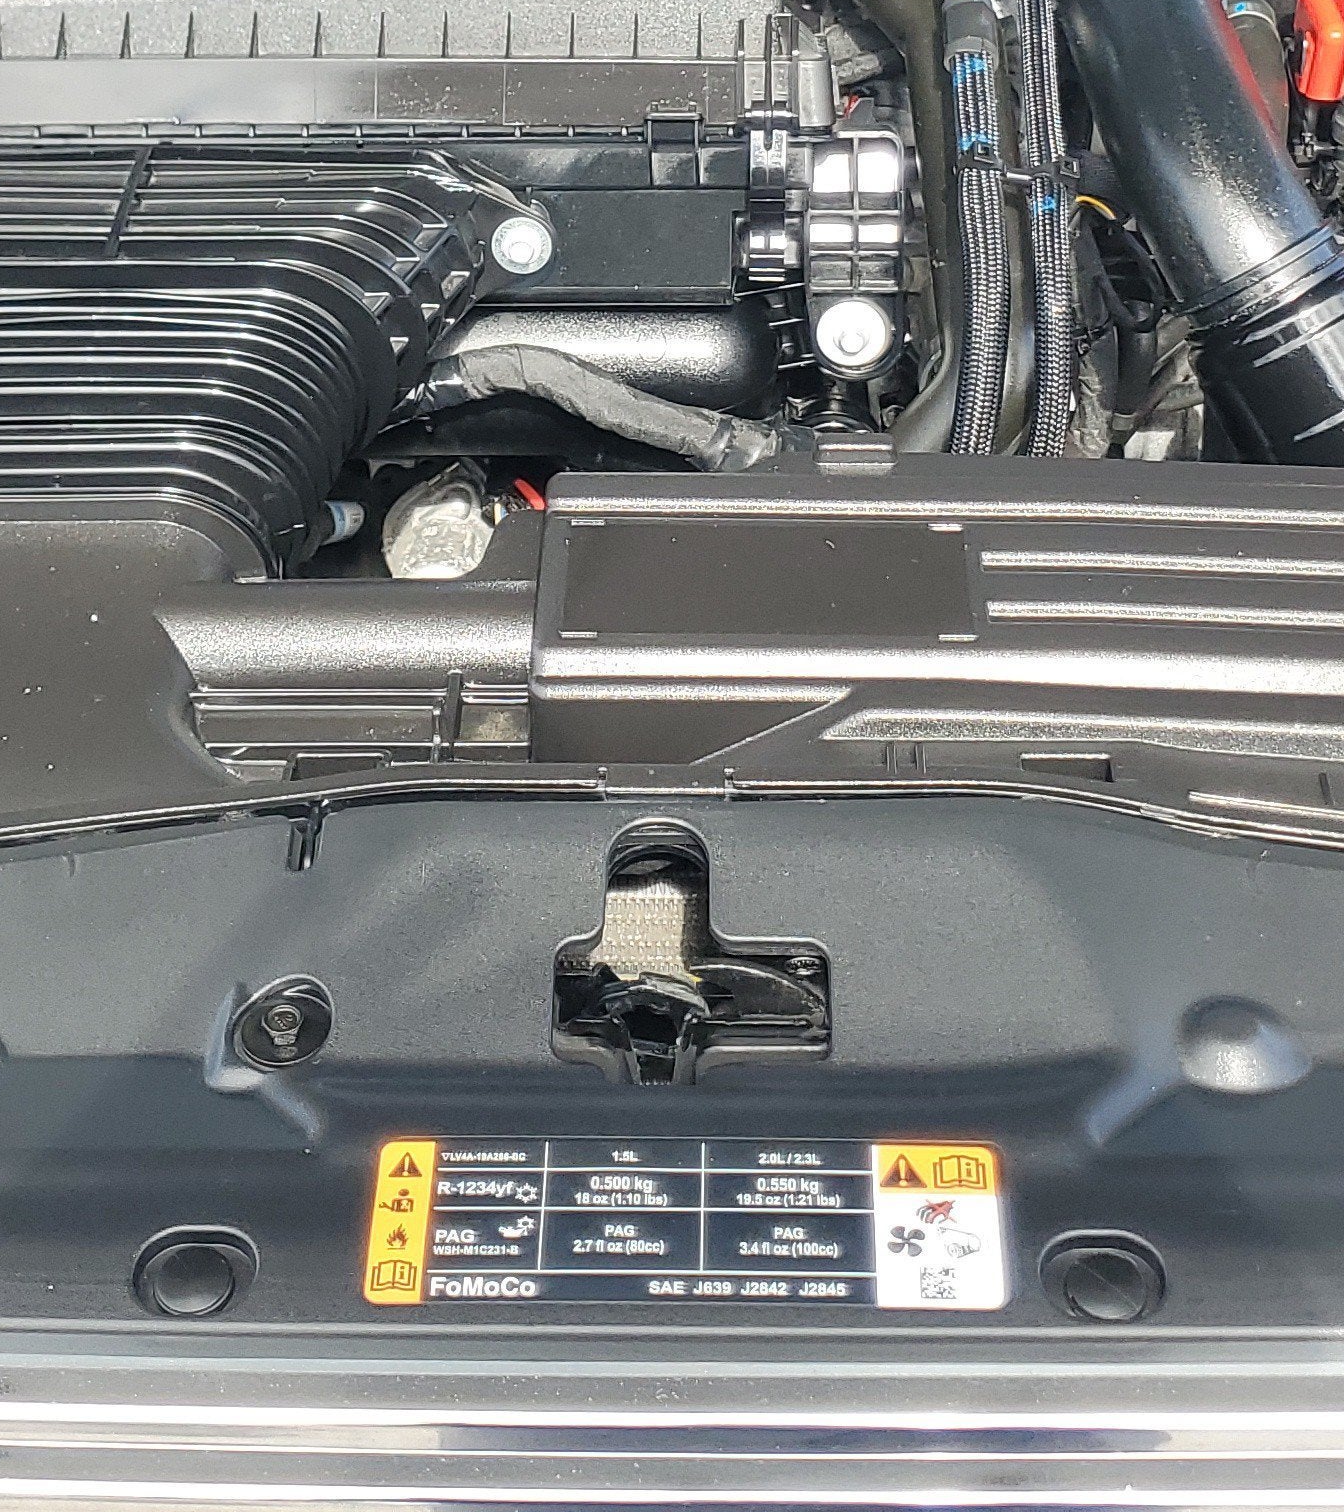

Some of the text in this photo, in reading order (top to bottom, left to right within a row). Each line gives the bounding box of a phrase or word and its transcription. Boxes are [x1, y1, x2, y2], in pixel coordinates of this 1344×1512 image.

[437, 1181, 514, 1197] R-1234yf
[590, 1176, 653, 1193] 0.500 kg
[757, 1178, 819, 1194] 0.550 kg
[575, 1192, 667, 1206] 18 oz (1.10 lbs)
[765, 1196, 781, 1205] oz
[783, 1194, 813, 1207] (1.21
[816, 1194, 840, 1207] lbs)
[434, 1229, 475, 1243] PAG
[605, 1225, 635, 1237] PAG
[774, 1227, 804, 1239] PAG
[573, 1240, 664, 1255] 2.7 fl oz (80cc)
[740, 1242, 838, 1257] 3.4 fl oz (100cc)
[429, 1277, 536, 1296] FoMoCo
[649, 1281, 846, 1295] SAE J639 J2842 J2845
